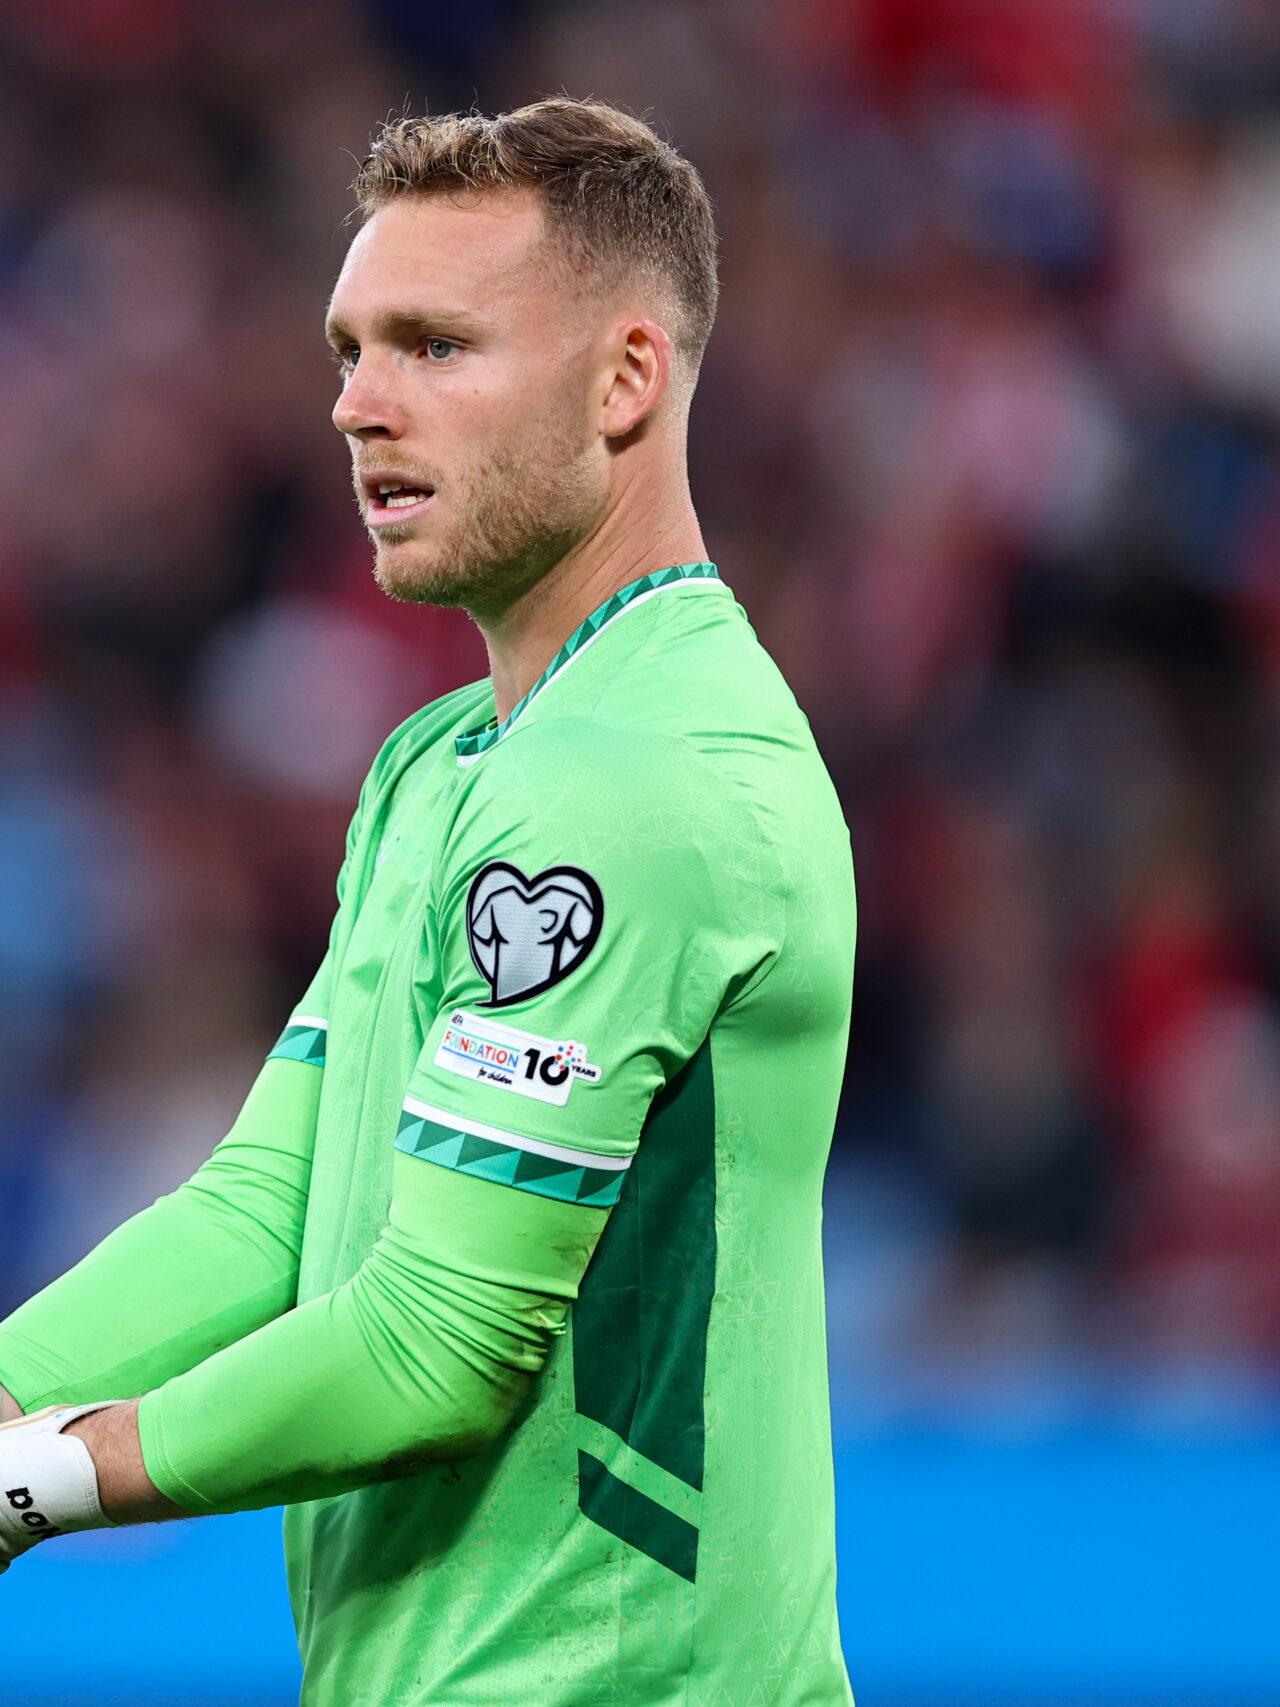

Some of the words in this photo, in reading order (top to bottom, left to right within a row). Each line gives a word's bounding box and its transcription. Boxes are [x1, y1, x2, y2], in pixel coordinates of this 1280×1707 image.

[444, 1030, 519, 1068] FOUNDATION
[524, 1048, 569, 1086] 10
[572, 1065, 597, 1078] YEARS
[477, 1067, 488, 1079] for
[487, 1072, 513, 1086] children
